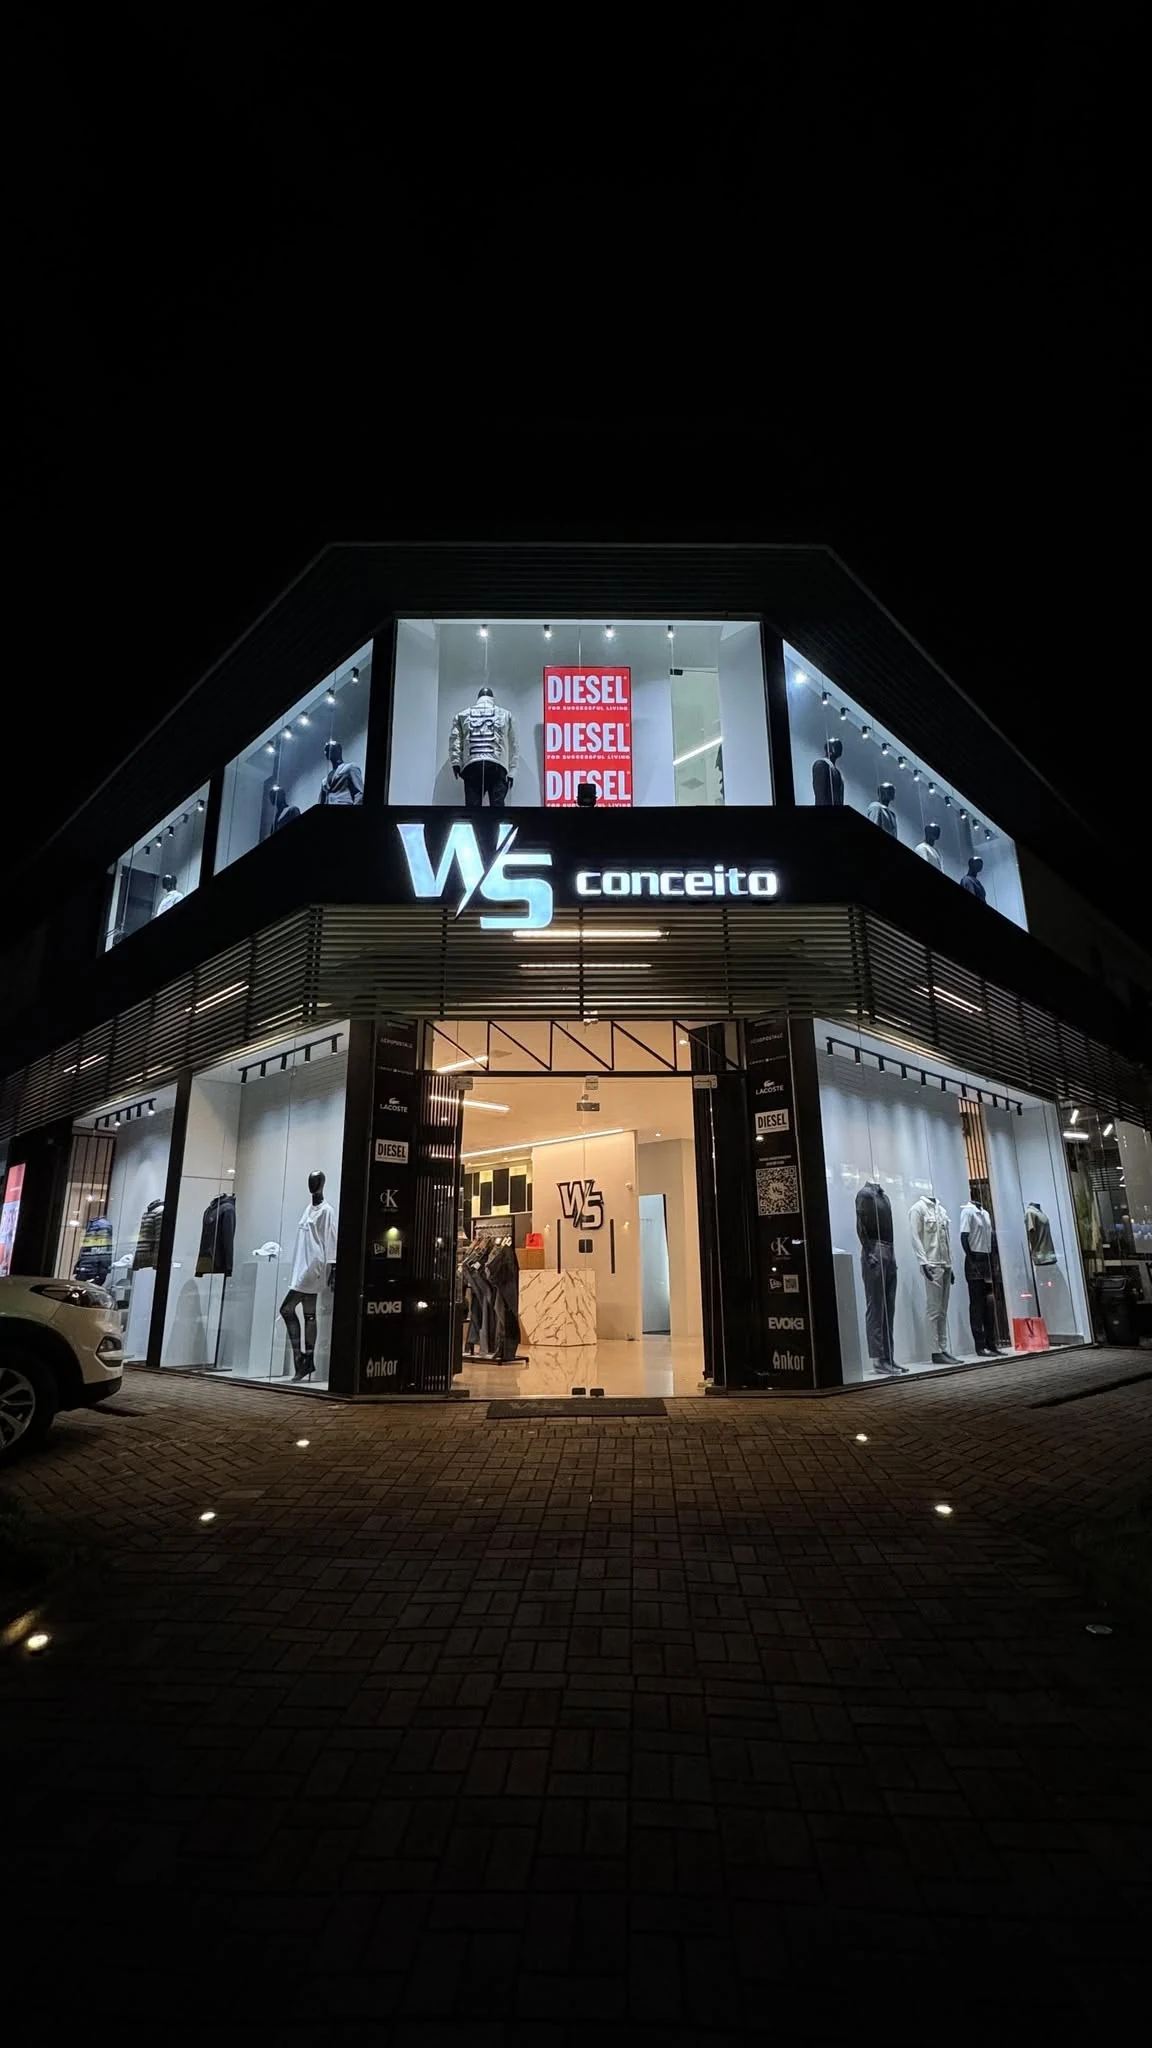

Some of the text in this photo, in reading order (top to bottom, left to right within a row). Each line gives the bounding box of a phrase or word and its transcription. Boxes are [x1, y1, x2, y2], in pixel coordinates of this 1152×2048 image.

[547, 675, 628, 704] DIESEL
[546, 722, 630, 753] DIESEL
[576, 863, 778, 897] conceito
[755, 1084, 784, 1095] LACOSTE
[380, 1103, 408, 1113] LACOSTE
[757, 1113, 787, 1129] DIESEL
[377, 1143, 406, 1158] DIESEL
[366, 1356, 398, 1377] Ankor
[772, 1350, 804, 1371] Ankor
